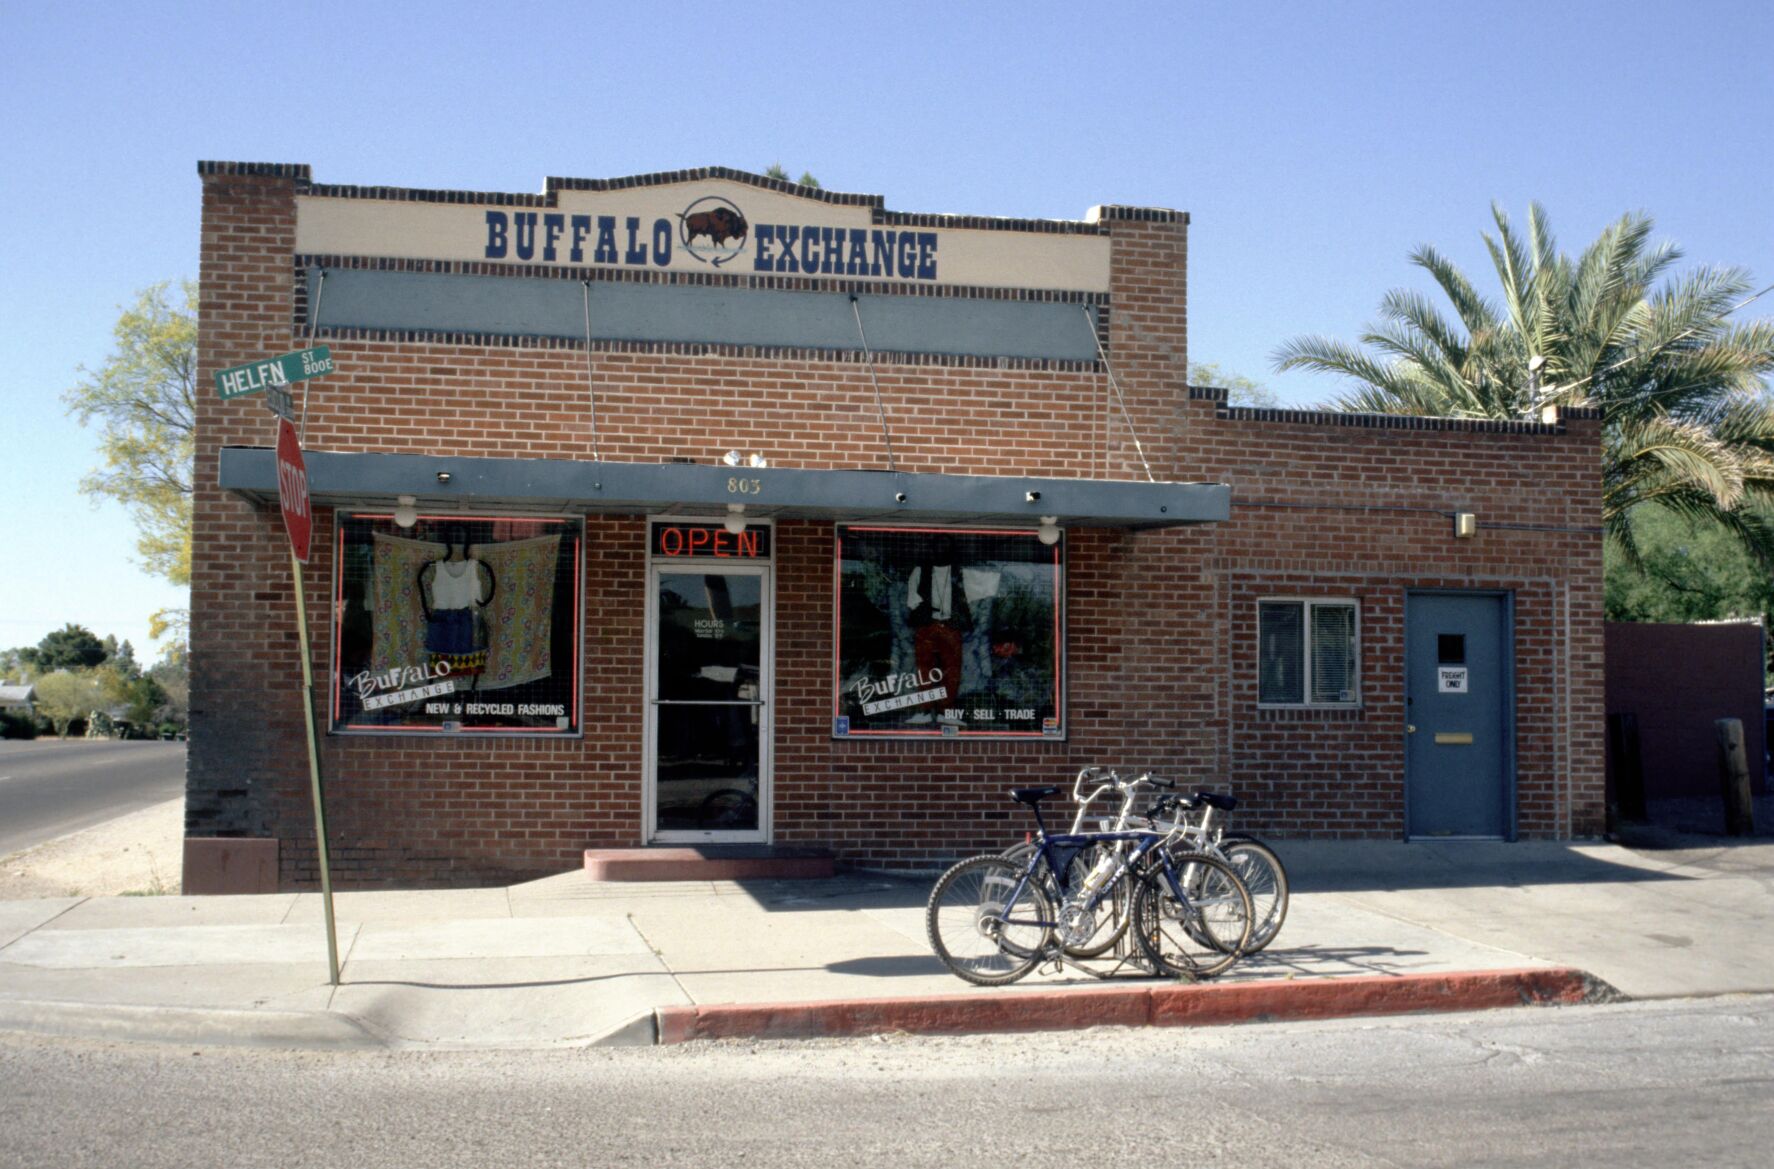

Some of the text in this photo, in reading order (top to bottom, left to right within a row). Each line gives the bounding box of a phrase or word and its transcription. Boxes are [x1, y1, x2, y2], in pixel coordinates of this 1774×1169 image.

[485, 210, 938, 280] BUFFALO EXCHANGE
[301, 351, 314, 364] ST
[304, 358, 333, 375] 800E
[222, 361, 286, 395] HELEN
[280, 459, 307, 518] STOP
[727, 477, 761, 494] 803
[661, 527, 758, 558] OPEN
[694, 619, 724, 628] HOURS
[364, 682, 454, 709] EXCHANGE
[864, 687, 946, 715] EXCHANGE
[426, 704, 564, 716] NEW & RECYCLED FASHIONS
[944, 709, 1035, 720] BUY SELL TRADE
